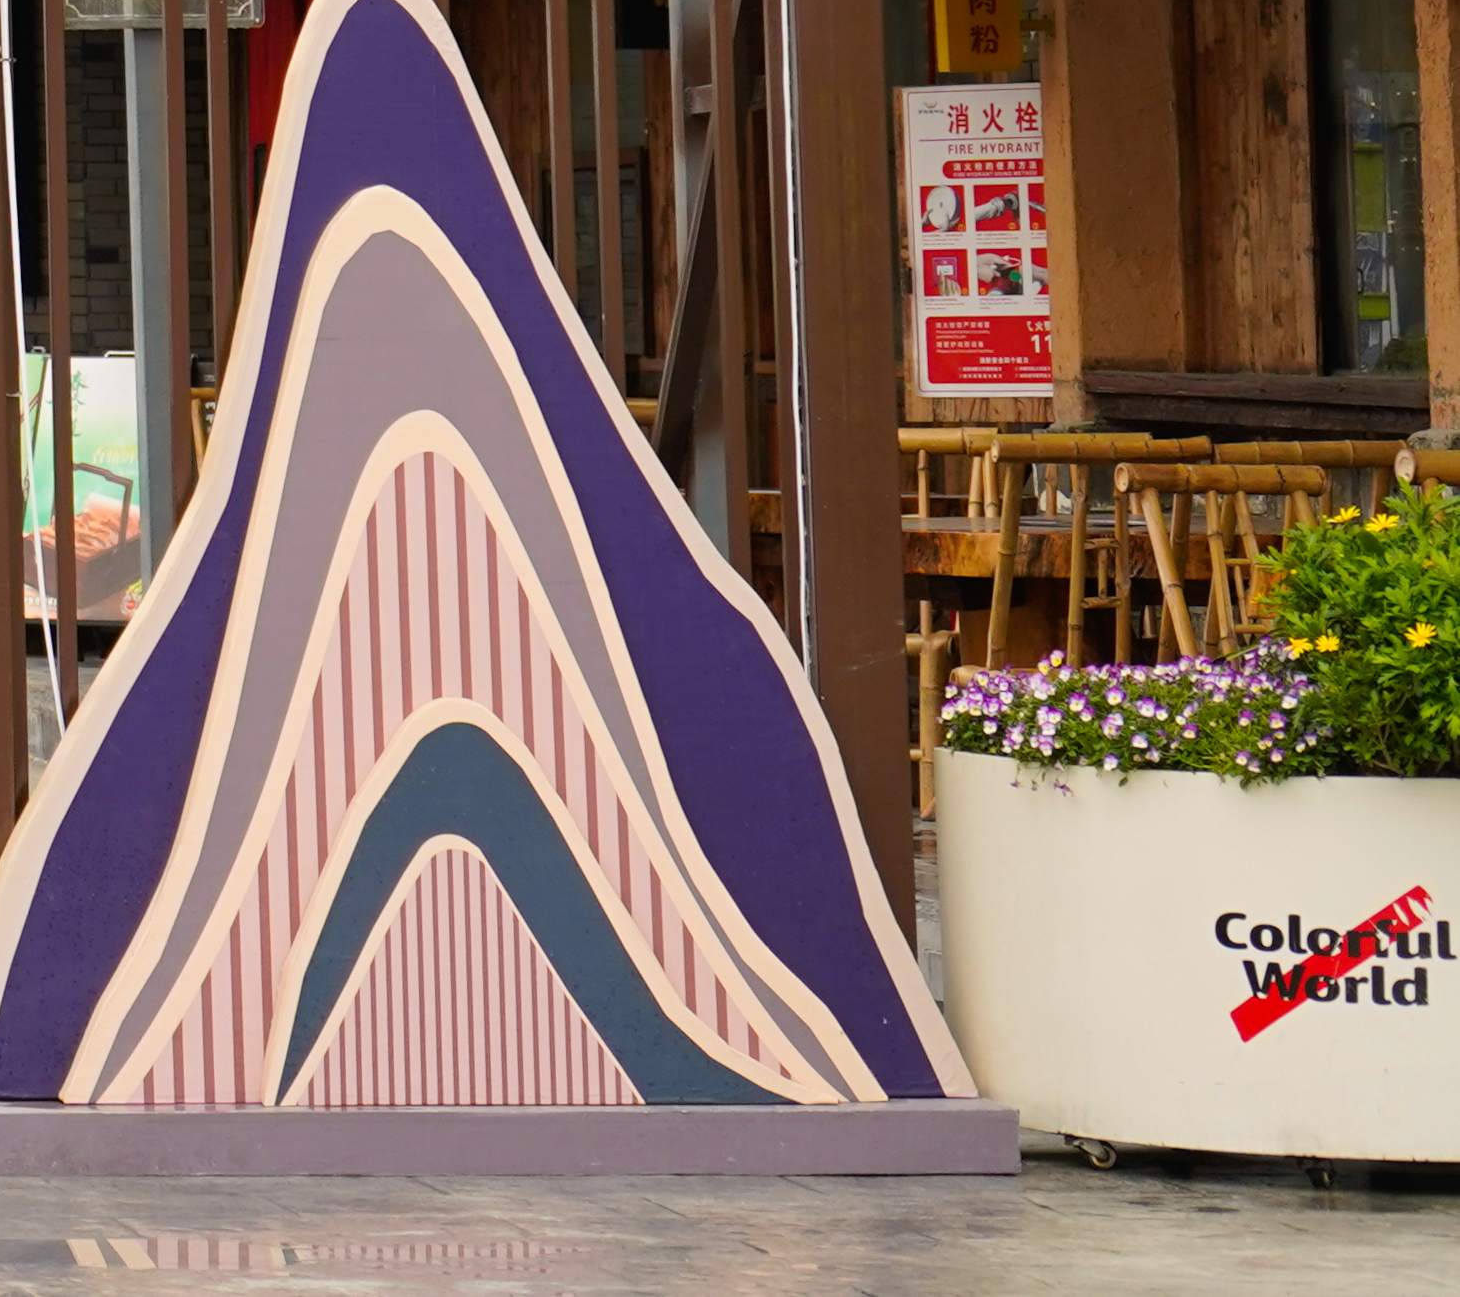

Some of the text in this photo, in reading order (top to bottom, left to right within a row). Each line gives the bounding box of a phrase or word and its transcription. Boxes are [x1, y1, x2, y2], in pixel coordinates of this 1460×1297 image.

[947, 101, 1039, 135] 消火栓
[948, 142, 1041, 155] FIRE HYDRANT
[1031, 334, 1051, 353] 11
[1215, 910, 1457, 962] Colorful
[1243, 960, 1429, 1008] World
